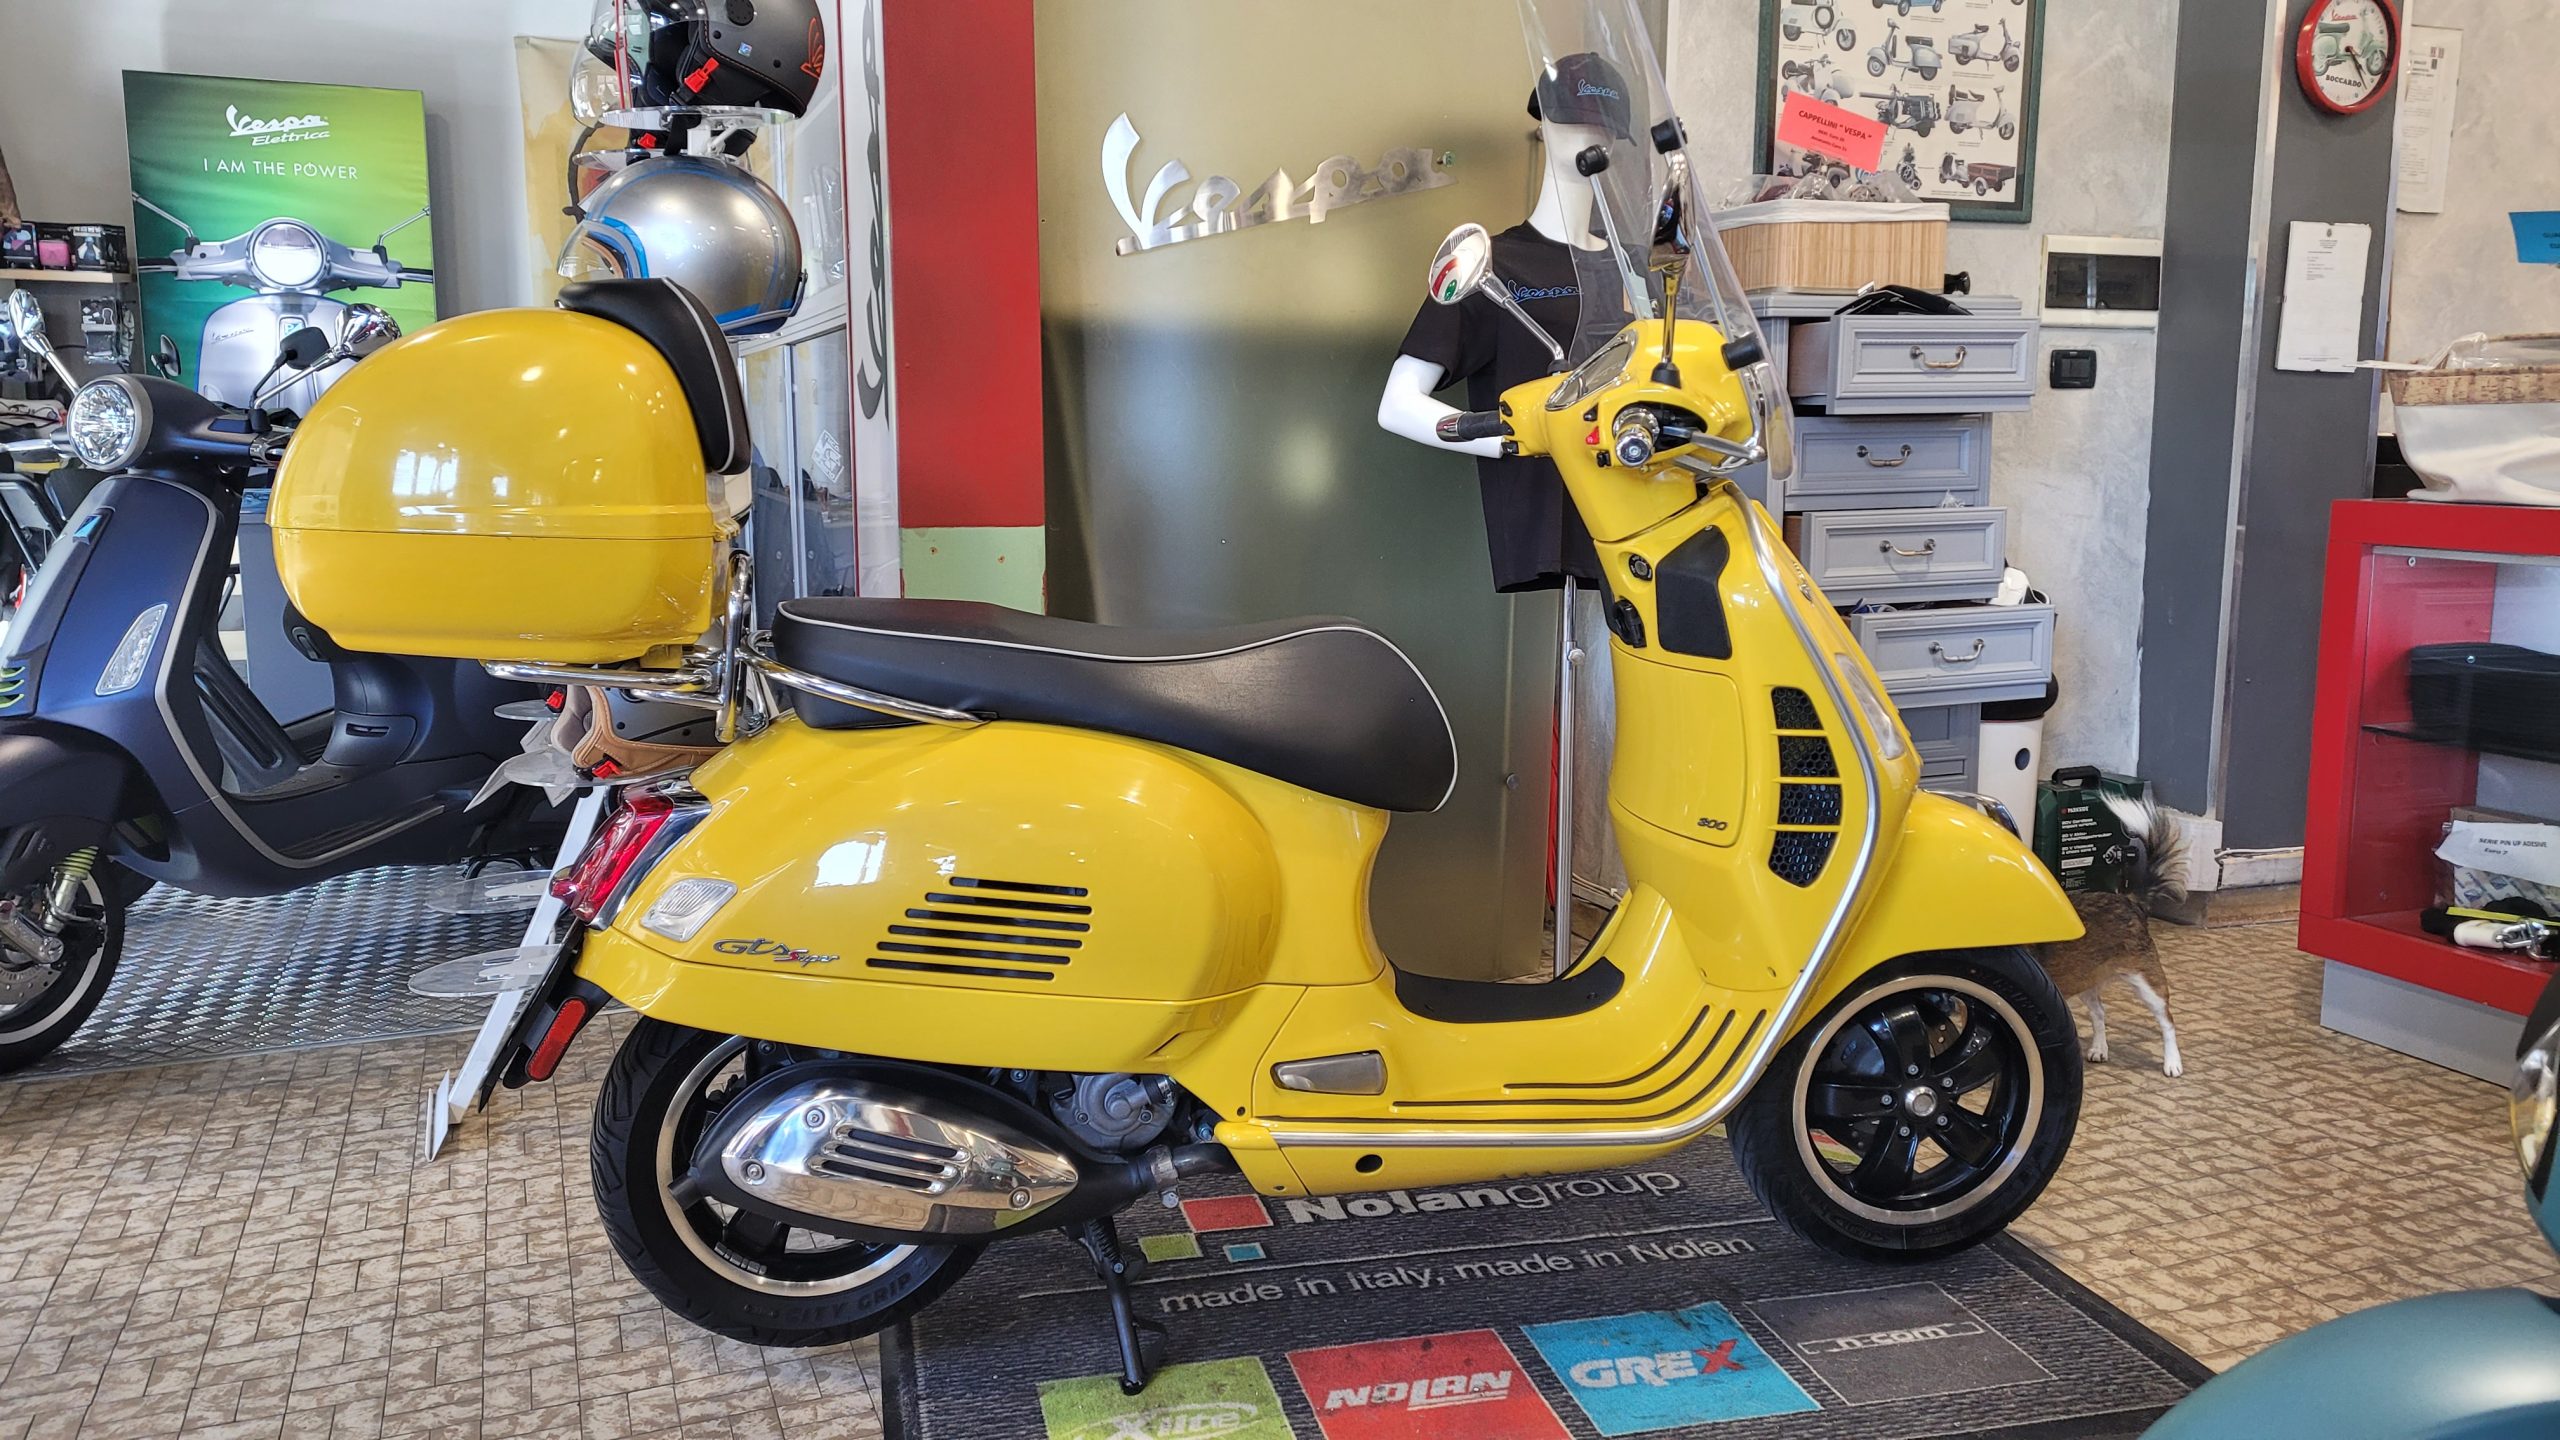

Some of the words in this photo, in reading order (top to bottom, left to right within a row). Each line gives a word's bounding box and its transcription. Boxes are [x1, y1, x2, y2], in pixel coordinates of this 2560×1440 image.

[1576, 78, 1620, 100] Vespa
[2325, 74, 2362, 88] BOCCARDO
[225, 104, 329, 137] Vespa
[1798, 110, 1838, 129] CAPPELLINI
[1844, 125, 1867, 140] VESPA
[251, 130, 331, 146] Elettrica
[203, 158, 208, 172] I
[216, 159, 246, 174] AM
[252, 160, 286, 176] THE
[294, 161, 358, 180] POWER
[1101, 111, 1460, 257] Vespa
[1507, 279, 1584, 304] Vespa
[1285, 1172, 1681, 1223] Nolangroup
[856, 1270, 913, 1311] GRIP
[1159, 1282, 1284, 1313] made
[1295, 1276, 1337, 1297] in
[1345, 1266, 1446, 1291] Italy,
[1453, 1251, 1574, 1280] made
[1580, 1249, 1624, 1268] in
[1625, 1238, 1756, 1264] Nolan
[1568, 1339, 1746, 1389] GREX
[1324, 1369, 1512, 1411] NOLAN
